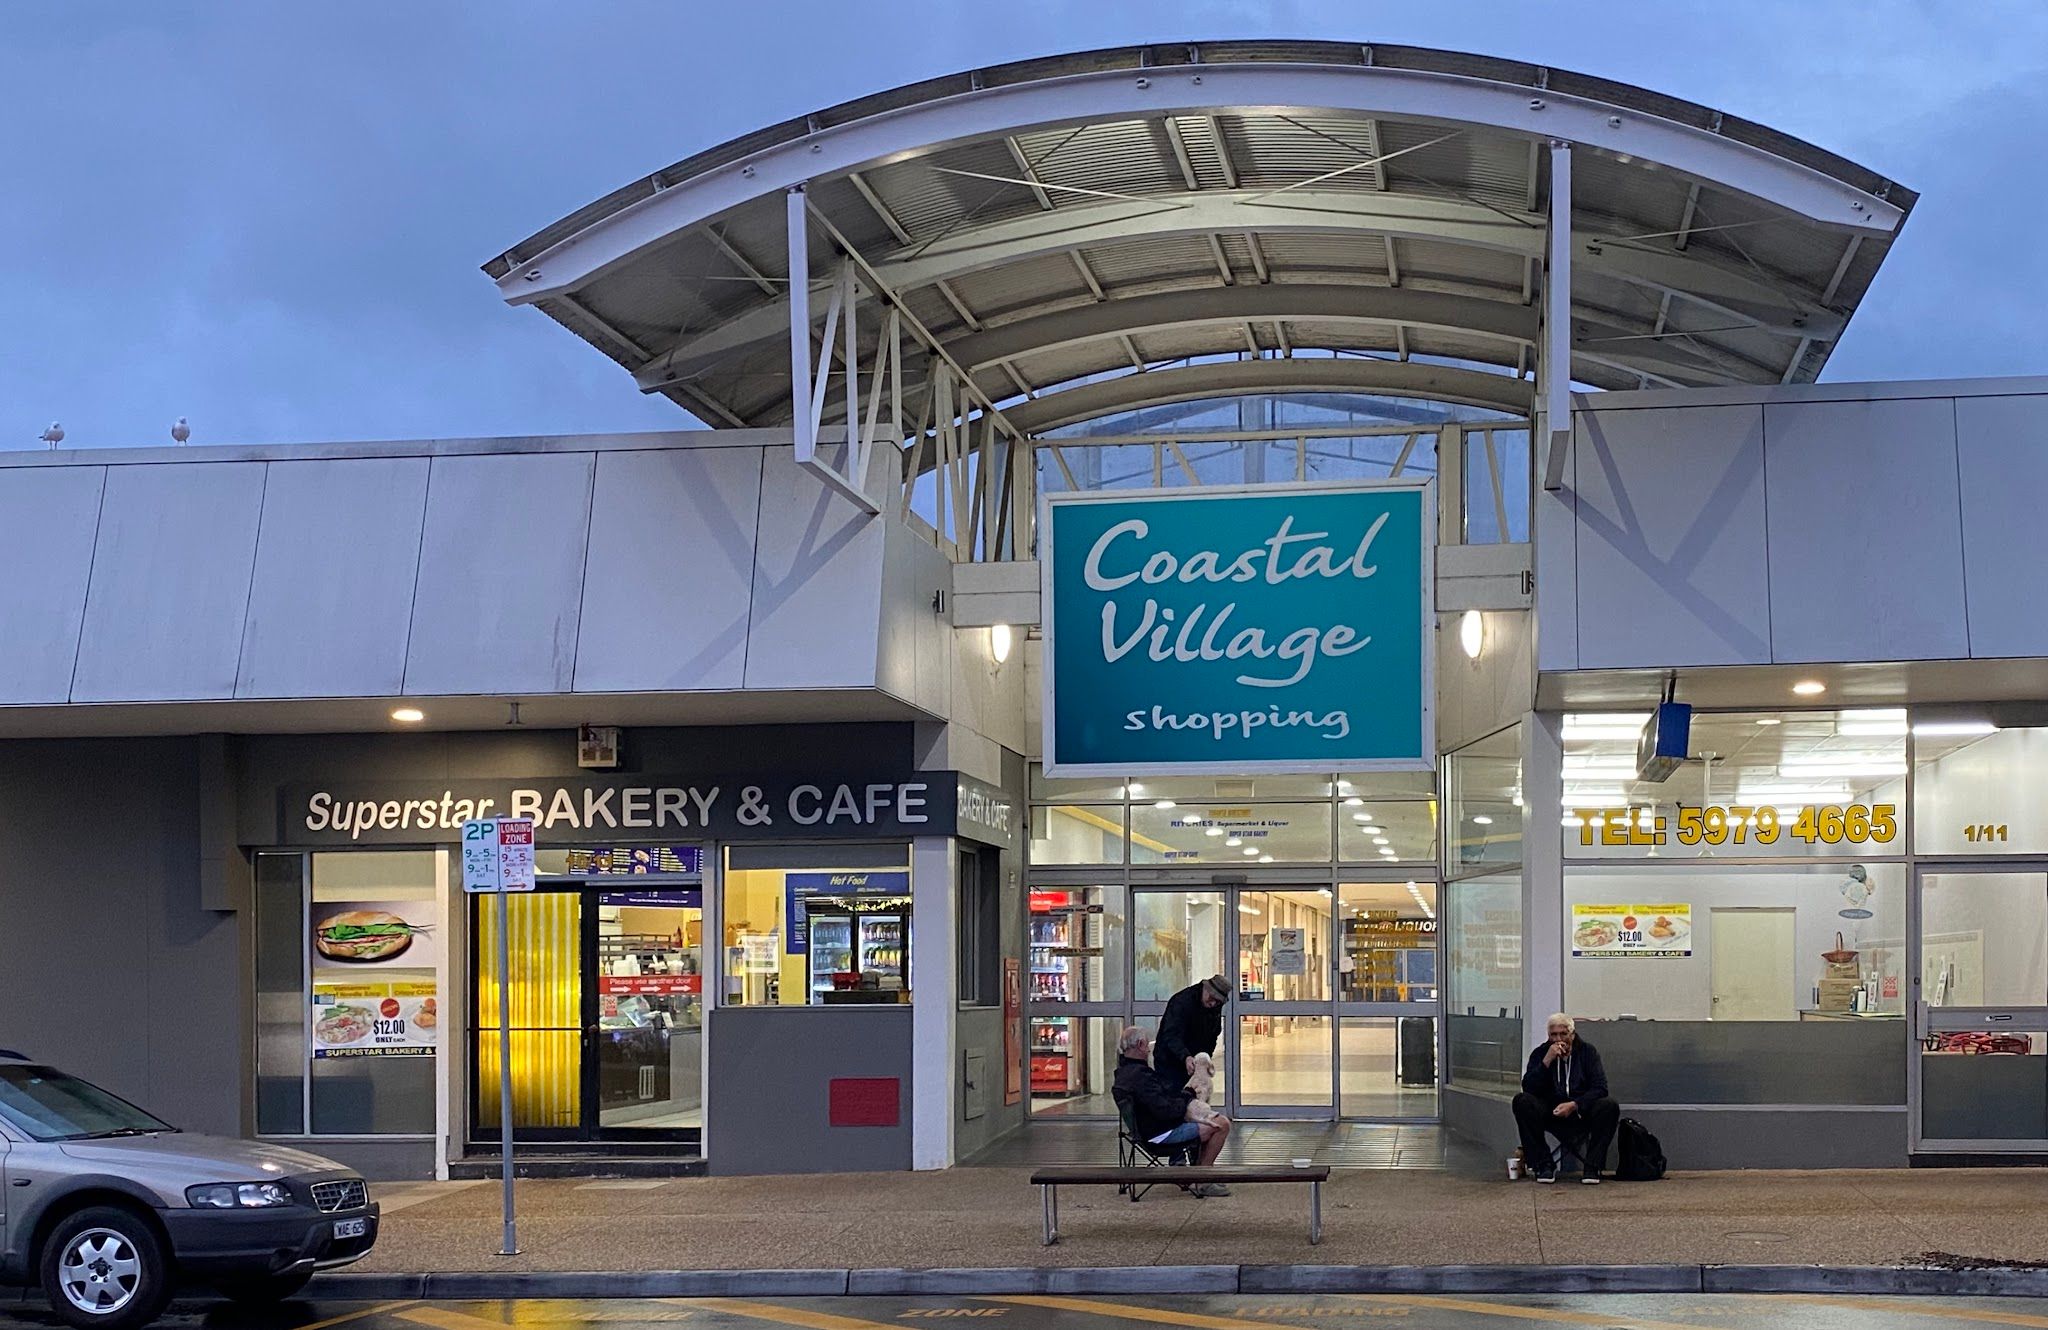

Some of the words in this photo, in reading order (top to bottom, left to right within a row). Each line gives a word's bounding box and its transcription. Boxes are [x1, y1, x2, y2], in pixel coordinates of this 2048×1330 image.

[1084, 511, 1390, 591] Coastal
[1101, 598, 1372, 687] Village
[1123, 704, 1350, 739] shopping
[306, 790, 494, 840] Superstar
[511, 786, 720, 829] BAKERY
[736, 785, 773, 826] &
[787, 783, 929, 825] CAFE
[466, 823, 495, 840] 2P
[501, 823, 531, 833] LOADING
[1572, 807, 1666, 846] TEL:
[1677, 806, 1781, 846] 5979
[1791, 804, 1897, 844] 4665
[1964, 824, 2008, 842] 1/11
[505, 833, 527, 844] ZONE
[830, 876, 845, 885] Hot
[846, 874, 868, 885] Food
[1618, 931, 1642, 942] $12.00
[373, 1019, 405, 1035] $12.00
[325, 1047, 382, 1057] SUPERSTAR
[385, 1047, 423, 1055] BAKERY
[896, 1308, 1010, 1318] ZONE
